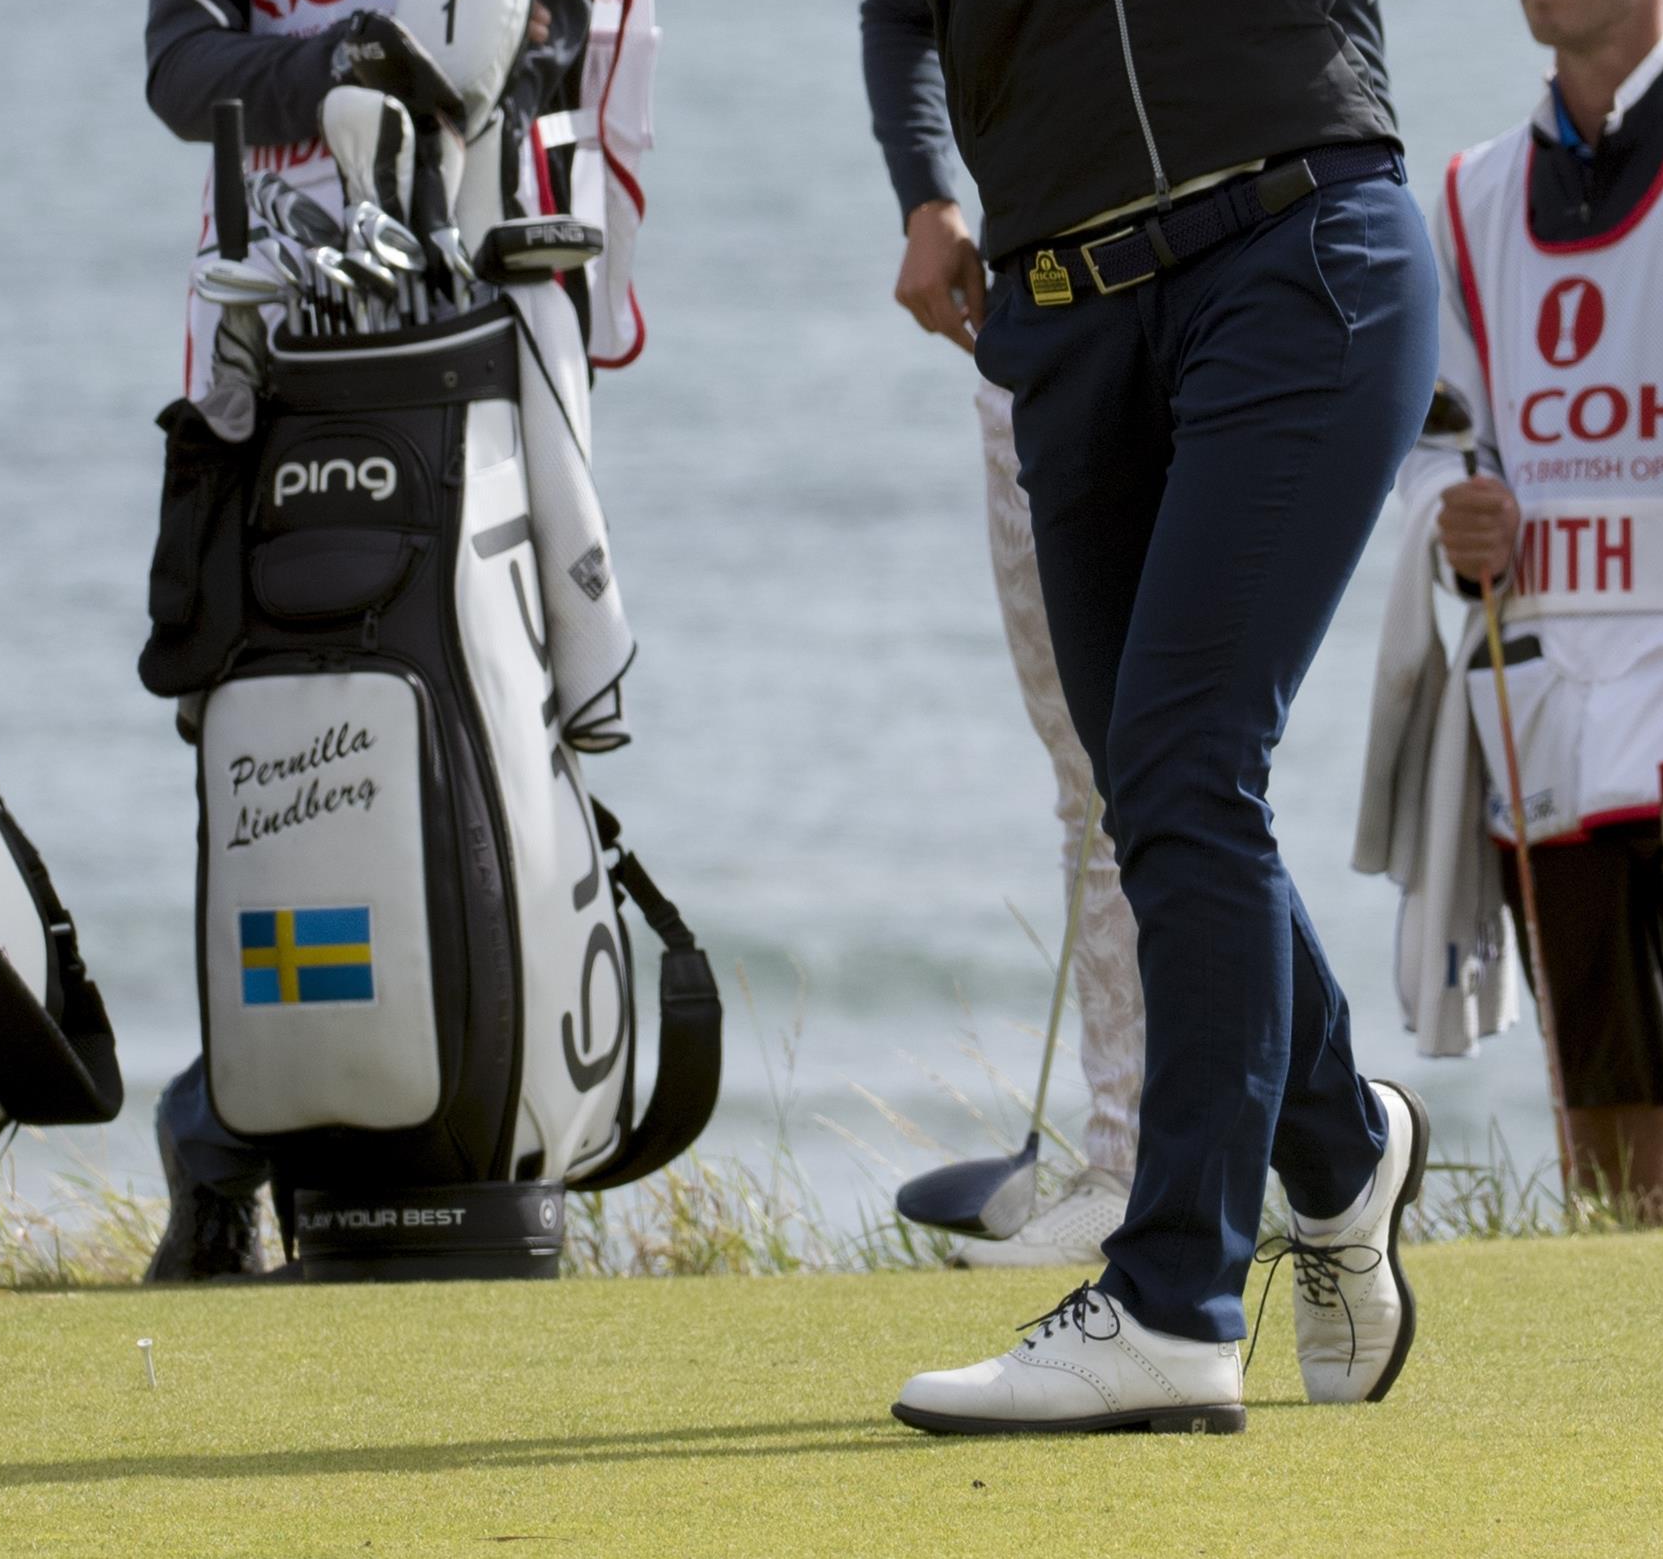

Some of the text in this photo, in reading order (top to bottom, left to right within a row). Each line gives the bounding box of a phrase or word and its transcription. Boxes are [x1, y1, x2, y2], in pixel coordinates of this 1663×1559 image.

[526, 225, 584, 246] PING
[1537, 457, 1622, 482] BRITISH
[1515, 516, 1632, 596] MITH
[229, 722, 377, 795] Pernilla
[226, 777, 380, 850] Lindberg
[336, 1209, 397, 1228] YOUR
[403, 1208, 466, 1226] BEST
